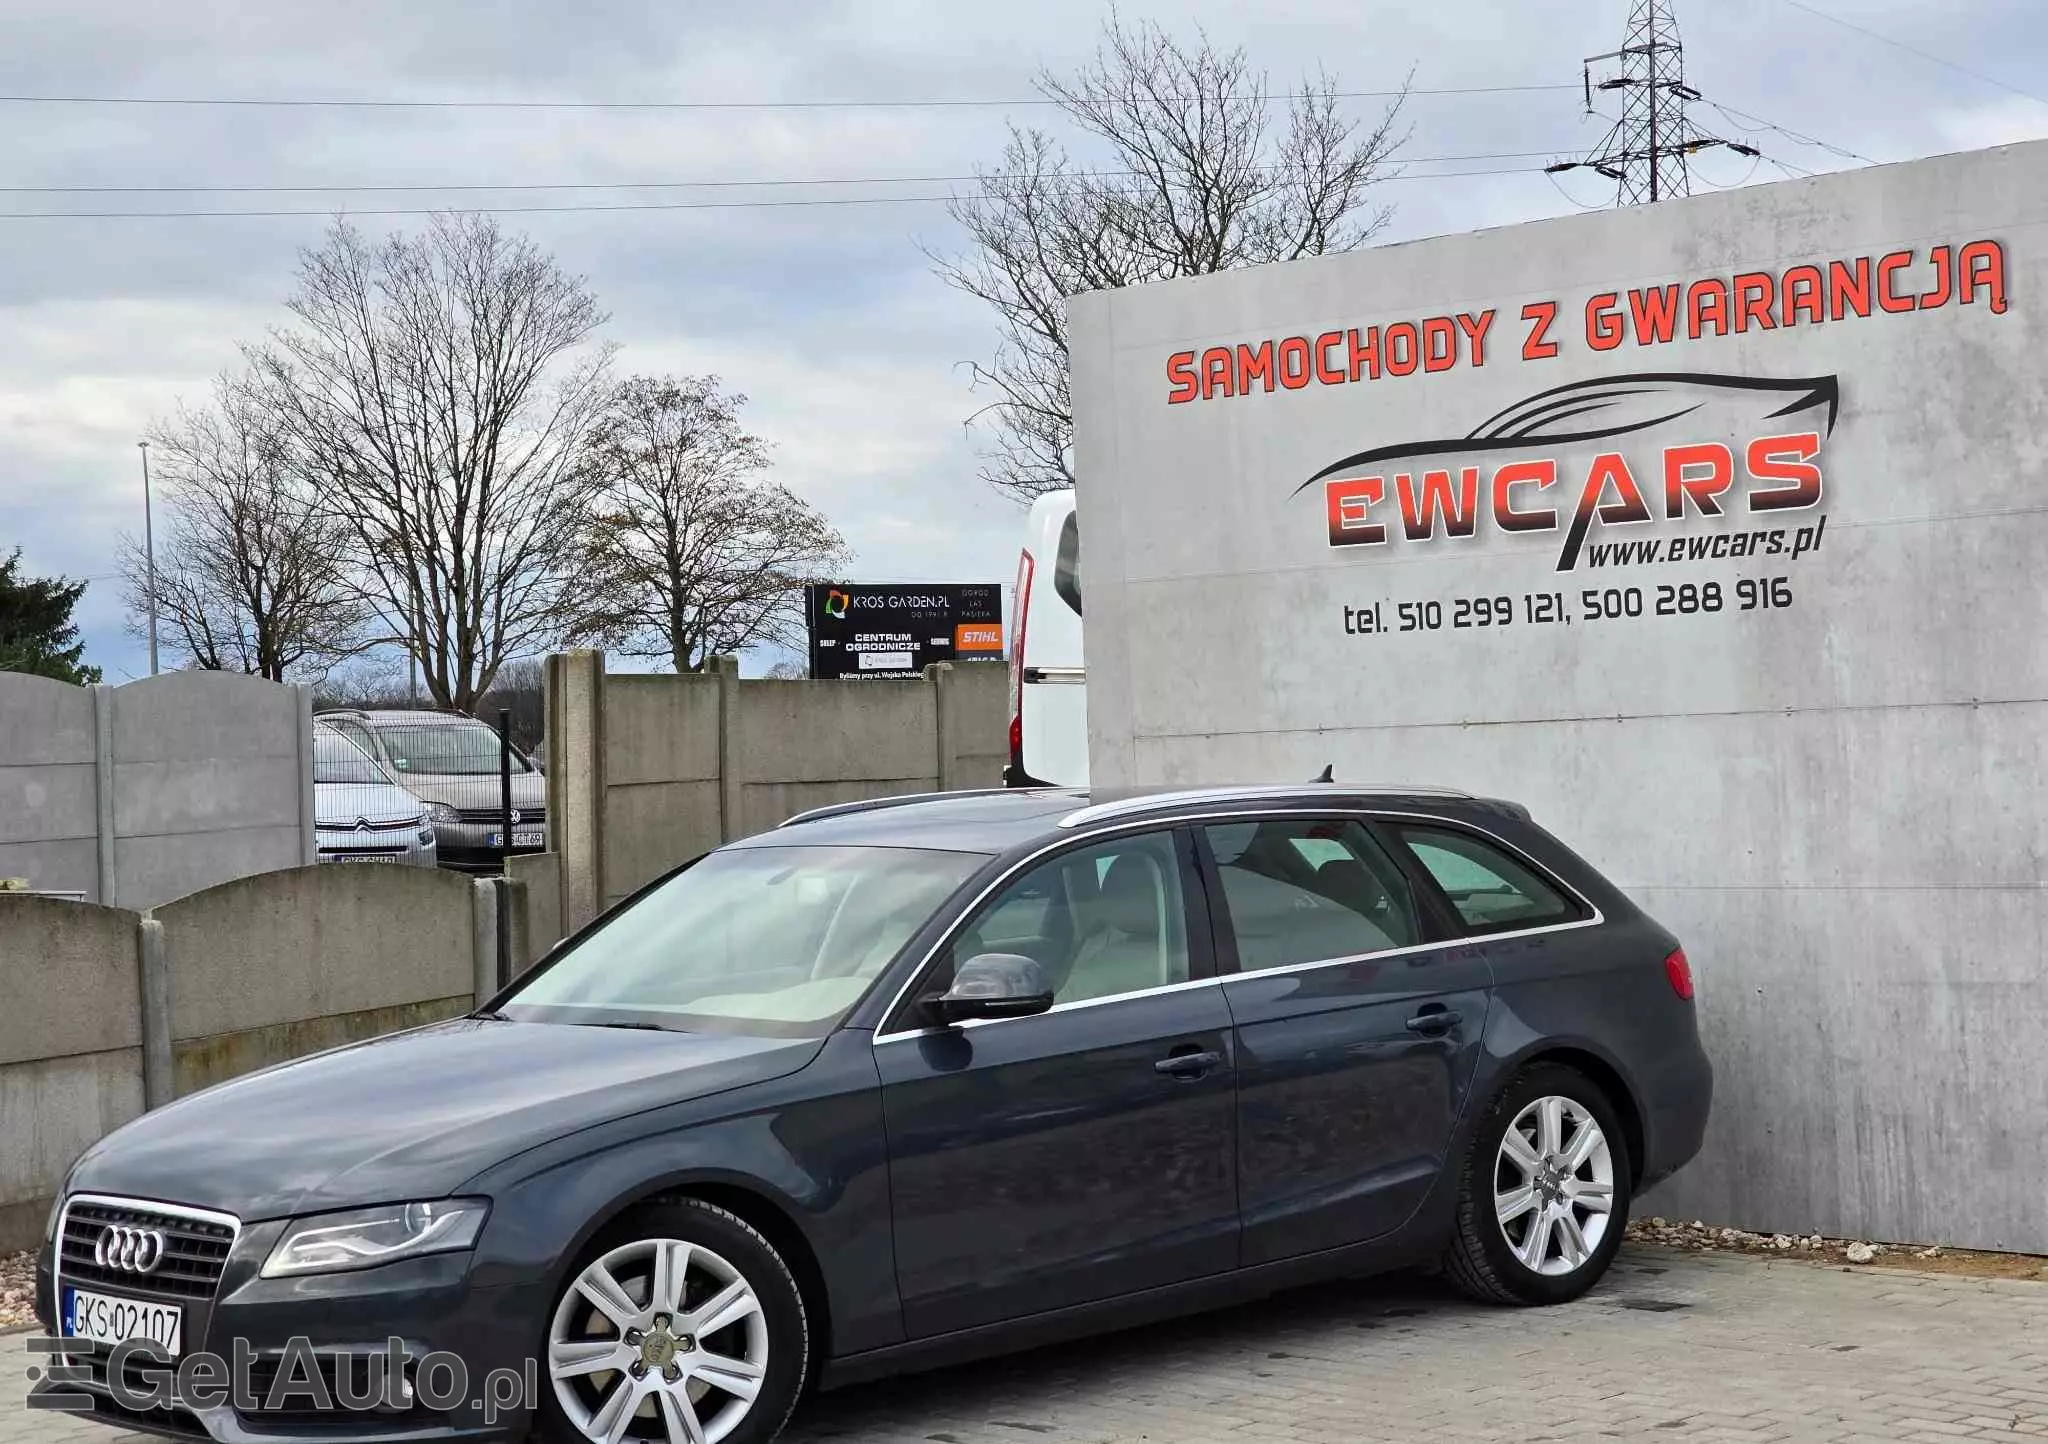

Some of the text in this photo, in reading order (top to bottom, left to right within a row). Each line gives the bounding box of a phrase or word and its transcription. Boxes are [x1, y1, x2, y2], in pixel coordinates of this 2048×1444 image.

[1165, 239, 2009, 405] SAMOCHODY Z GWARANCJĄ
[1324, 432, 1823, 573] EWCARS
[1588, 515, 1827, 568] www.ewcars.pl
[853, 594, 950, 608] KROS GARDEN.PL
[1343, 576, 1793, 635] tel. 510 299 121, 500 288 916
[845, 642, 921, 652] OGRODNICZE
[855, 633, 912, 642] CENTRUM
[963, 631, 999, 643] STIHL
